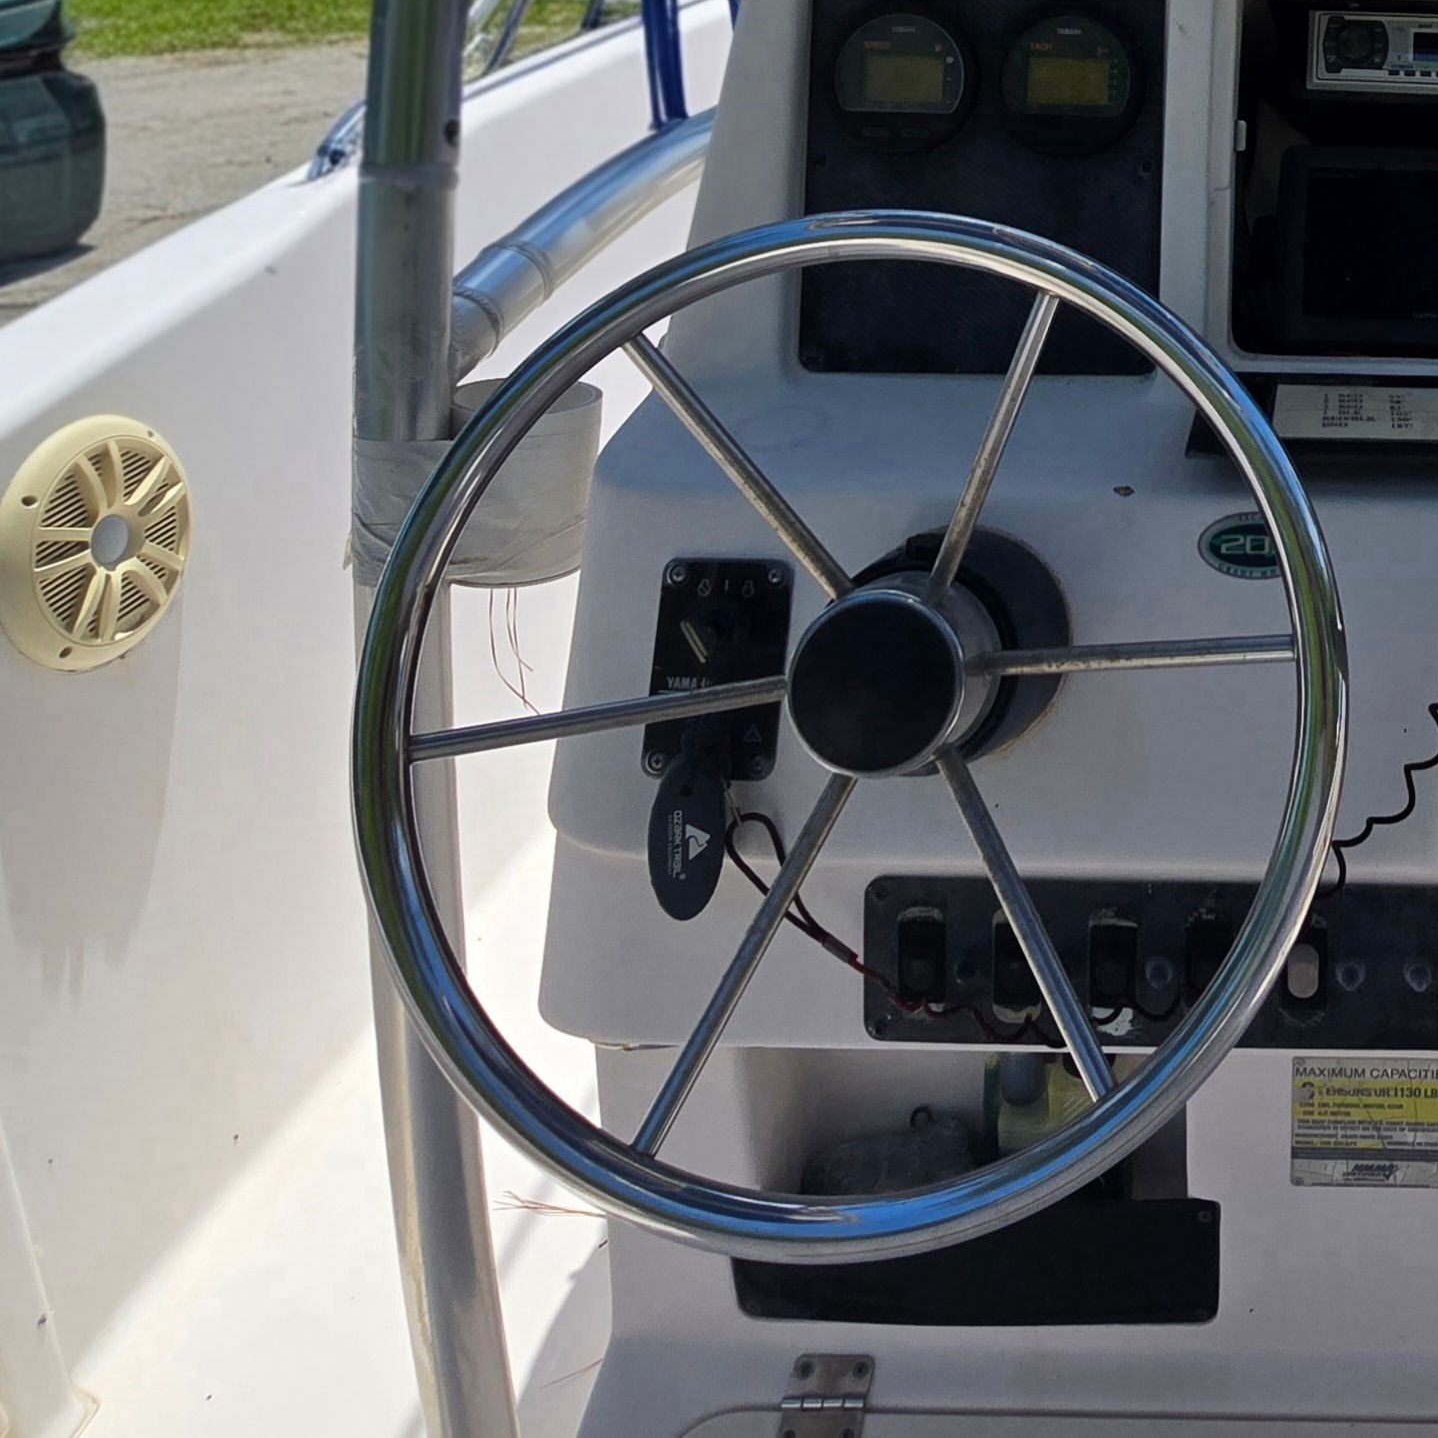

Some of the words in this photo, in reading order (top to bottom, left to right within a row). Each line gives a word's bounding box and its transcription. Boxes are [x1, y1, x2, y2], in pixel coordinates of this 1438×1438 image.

[1220, 534, 1275, 555] 20
[667, 674, 713, 691] YAMA
[1295, 1067, 1366, 1079] MAXIMUM
